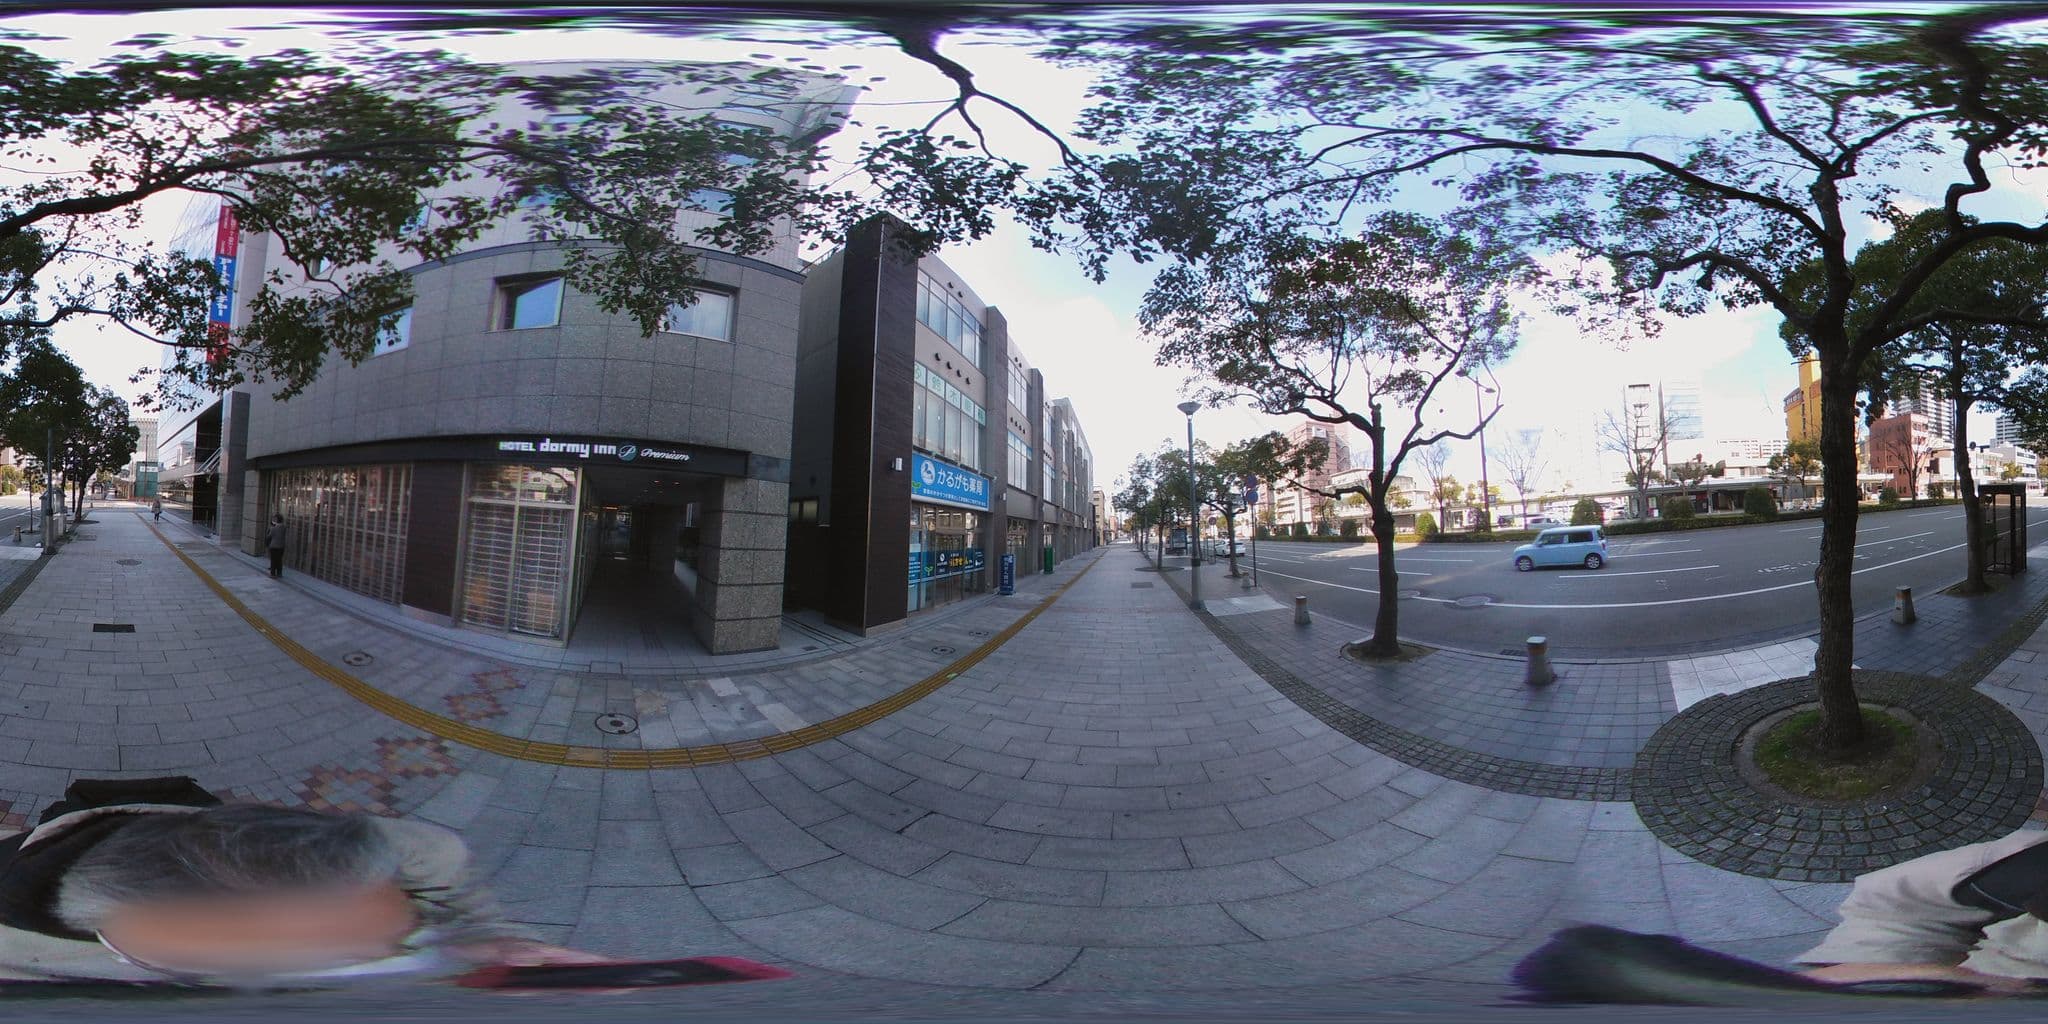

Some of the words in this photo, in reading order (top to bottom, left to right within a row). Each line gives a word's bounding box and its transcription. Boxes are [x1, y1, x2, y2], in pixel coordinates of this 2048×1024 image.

[216, 258, 232, 316] アートネチャー
[499, 441, 535, 452] HOTEL
[540, 438, 590, 458] dormy
[640, 449, 690, 461] Premium
[937, 468, 983, 496] かるがも薬局
